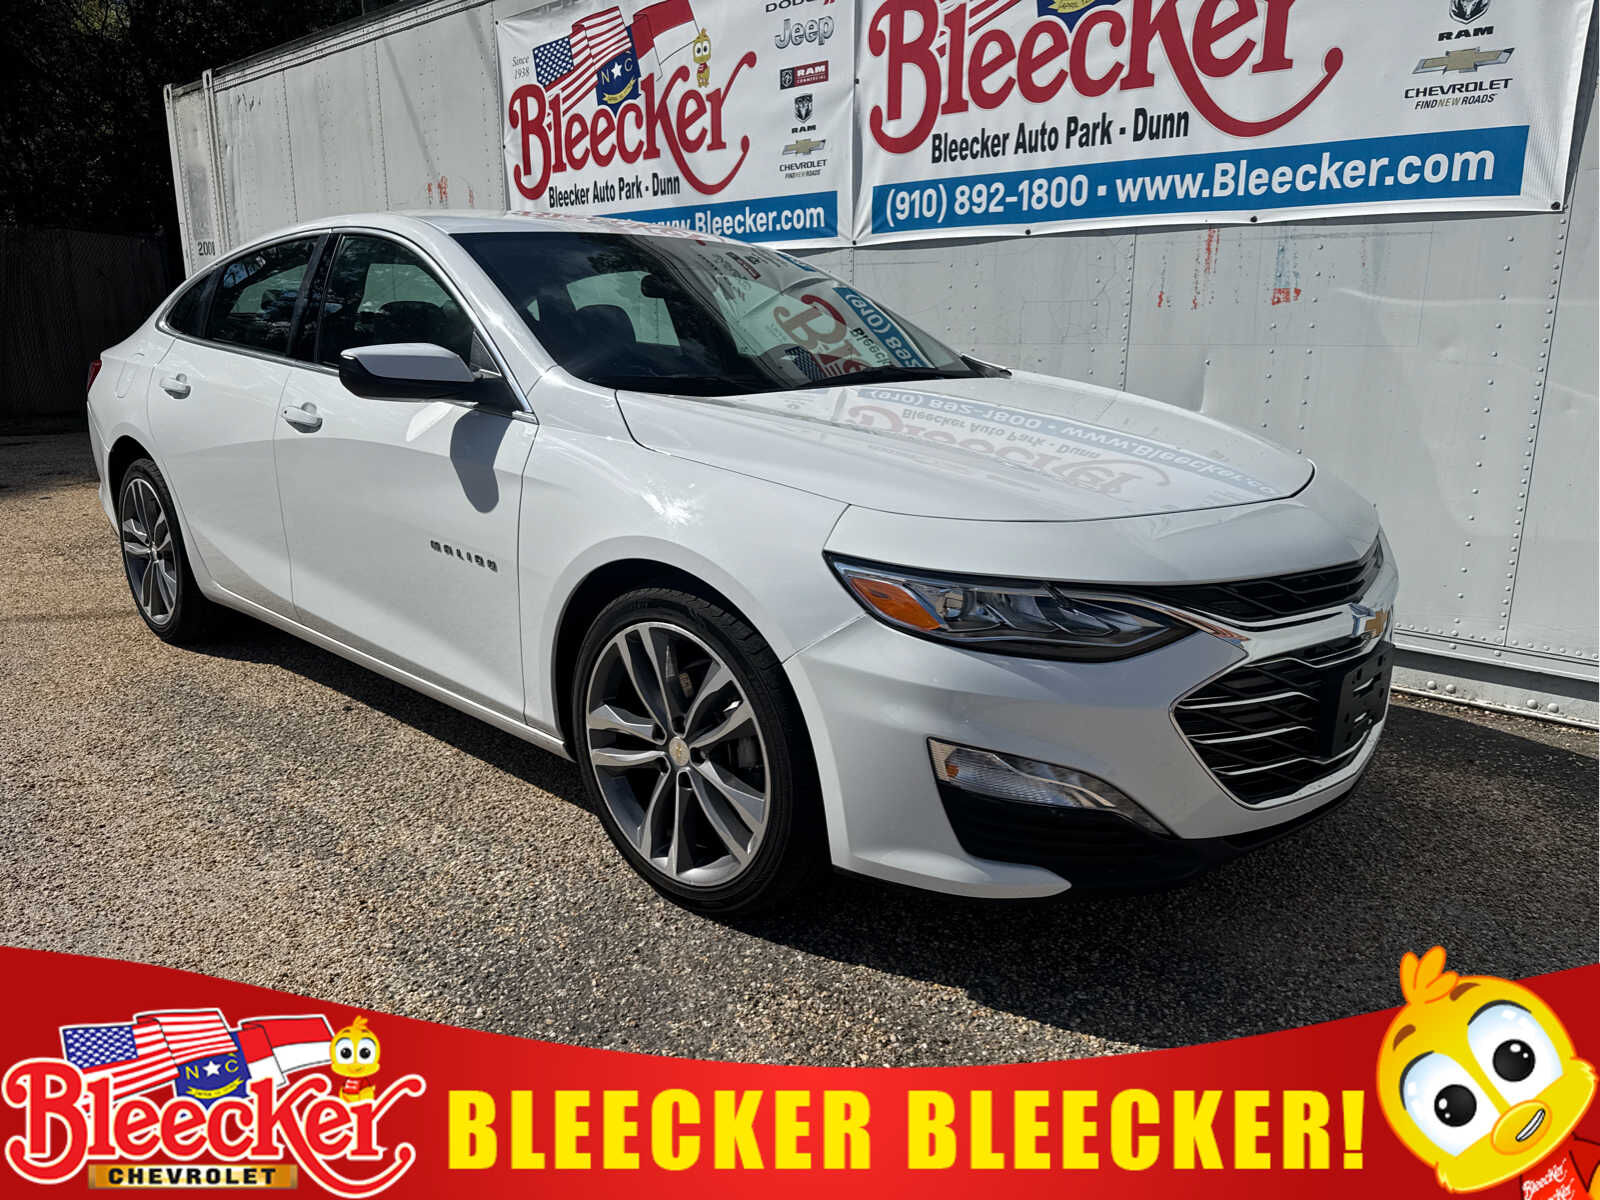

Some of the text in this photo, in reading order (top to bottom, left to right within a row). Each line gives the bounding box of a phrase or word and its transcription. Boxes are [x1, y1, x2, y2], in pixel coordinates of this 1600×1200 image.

[775, 16, 834, 49] Jeep
[1438, 26, 1494, 41] RAM
[512, 56, 530, 67] Since
[601, 58, 633, 85] N C
[797, 65, 826, 76] RAM
[868, 0, 1344, 154] Bleecker
[1405, 78, 1514, 98] CHEVROLET
[509, 51, 757, 200] Bleecker
[791, 125, 816, 134] RAM
[931, 107, 1189, 164] Bleecker Auto Park Dunn
[779, 159, 827, 171] CHEVROLET
[549, 174, 680, 208] Bleecker Auto Park Dunn
[886, 149, 1495, 227] (910) 892-1800 www.Bleecker.com
